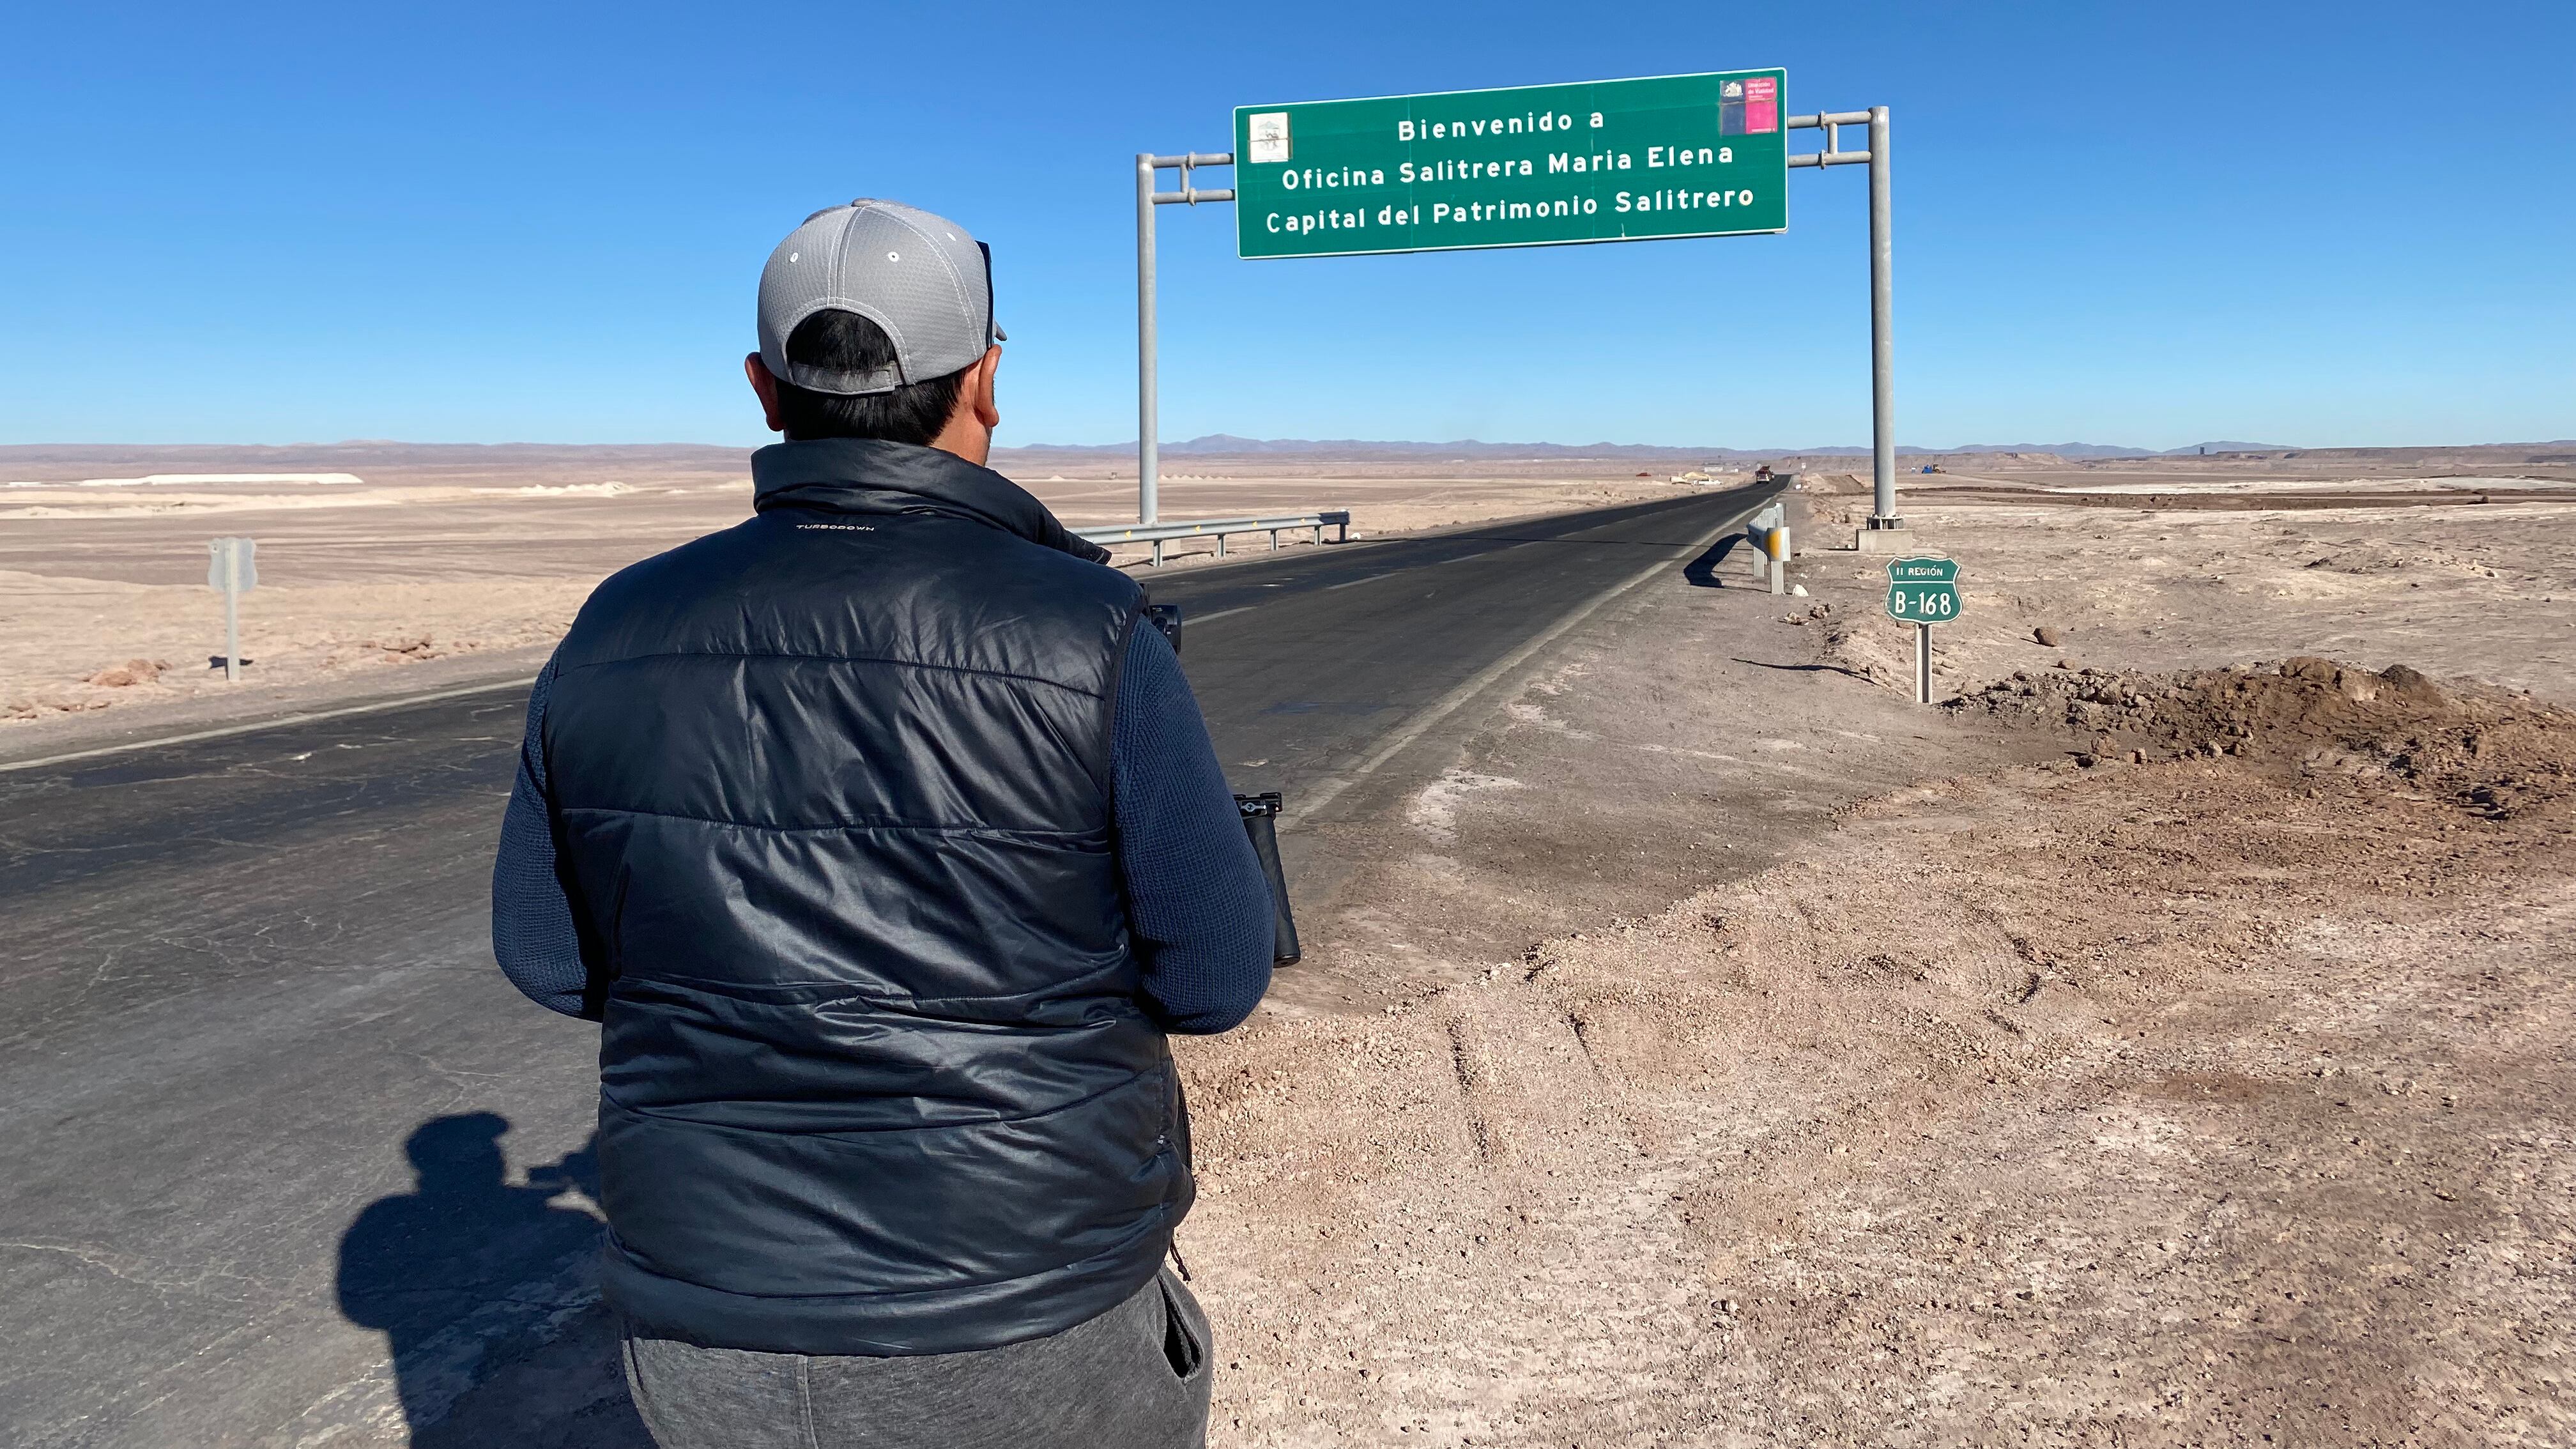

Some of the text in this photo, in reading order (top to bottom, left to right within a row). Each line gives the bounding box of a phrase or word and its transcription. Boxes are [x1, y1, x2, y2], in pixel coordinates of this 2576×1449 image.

[1399, 111, 1604, 141] Bienvenido a
[1282, 146, 1733, 190] Oficina Salitrera Maria Elena
[1266, 188, 1754, 235] Capital del Patrimonio Salitrero
[1896, 564, 1943, 576] II REGIÓN
[1895, 591, 1951, 615] B-168
